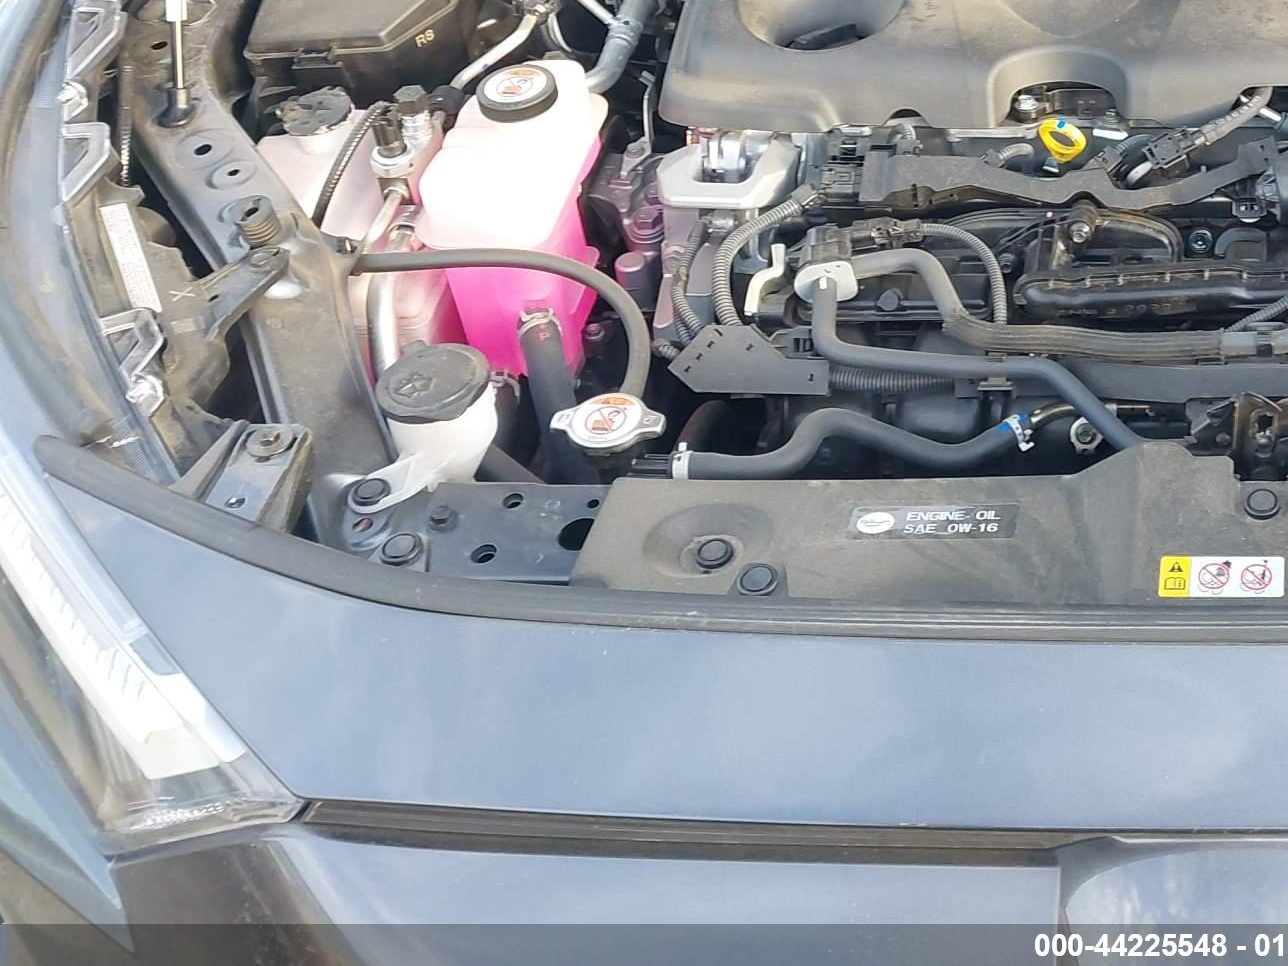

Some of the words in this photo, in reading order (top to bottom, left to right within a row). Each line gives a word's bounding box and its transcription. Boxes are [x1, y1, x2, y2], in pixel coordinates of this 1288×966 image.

[906, 511, 966, 521] ENGINE
[975, 510, 1001, 520] OIL
[903, 523, 938, 534] SAE
[947, 522, 999, 533] 0W-16
